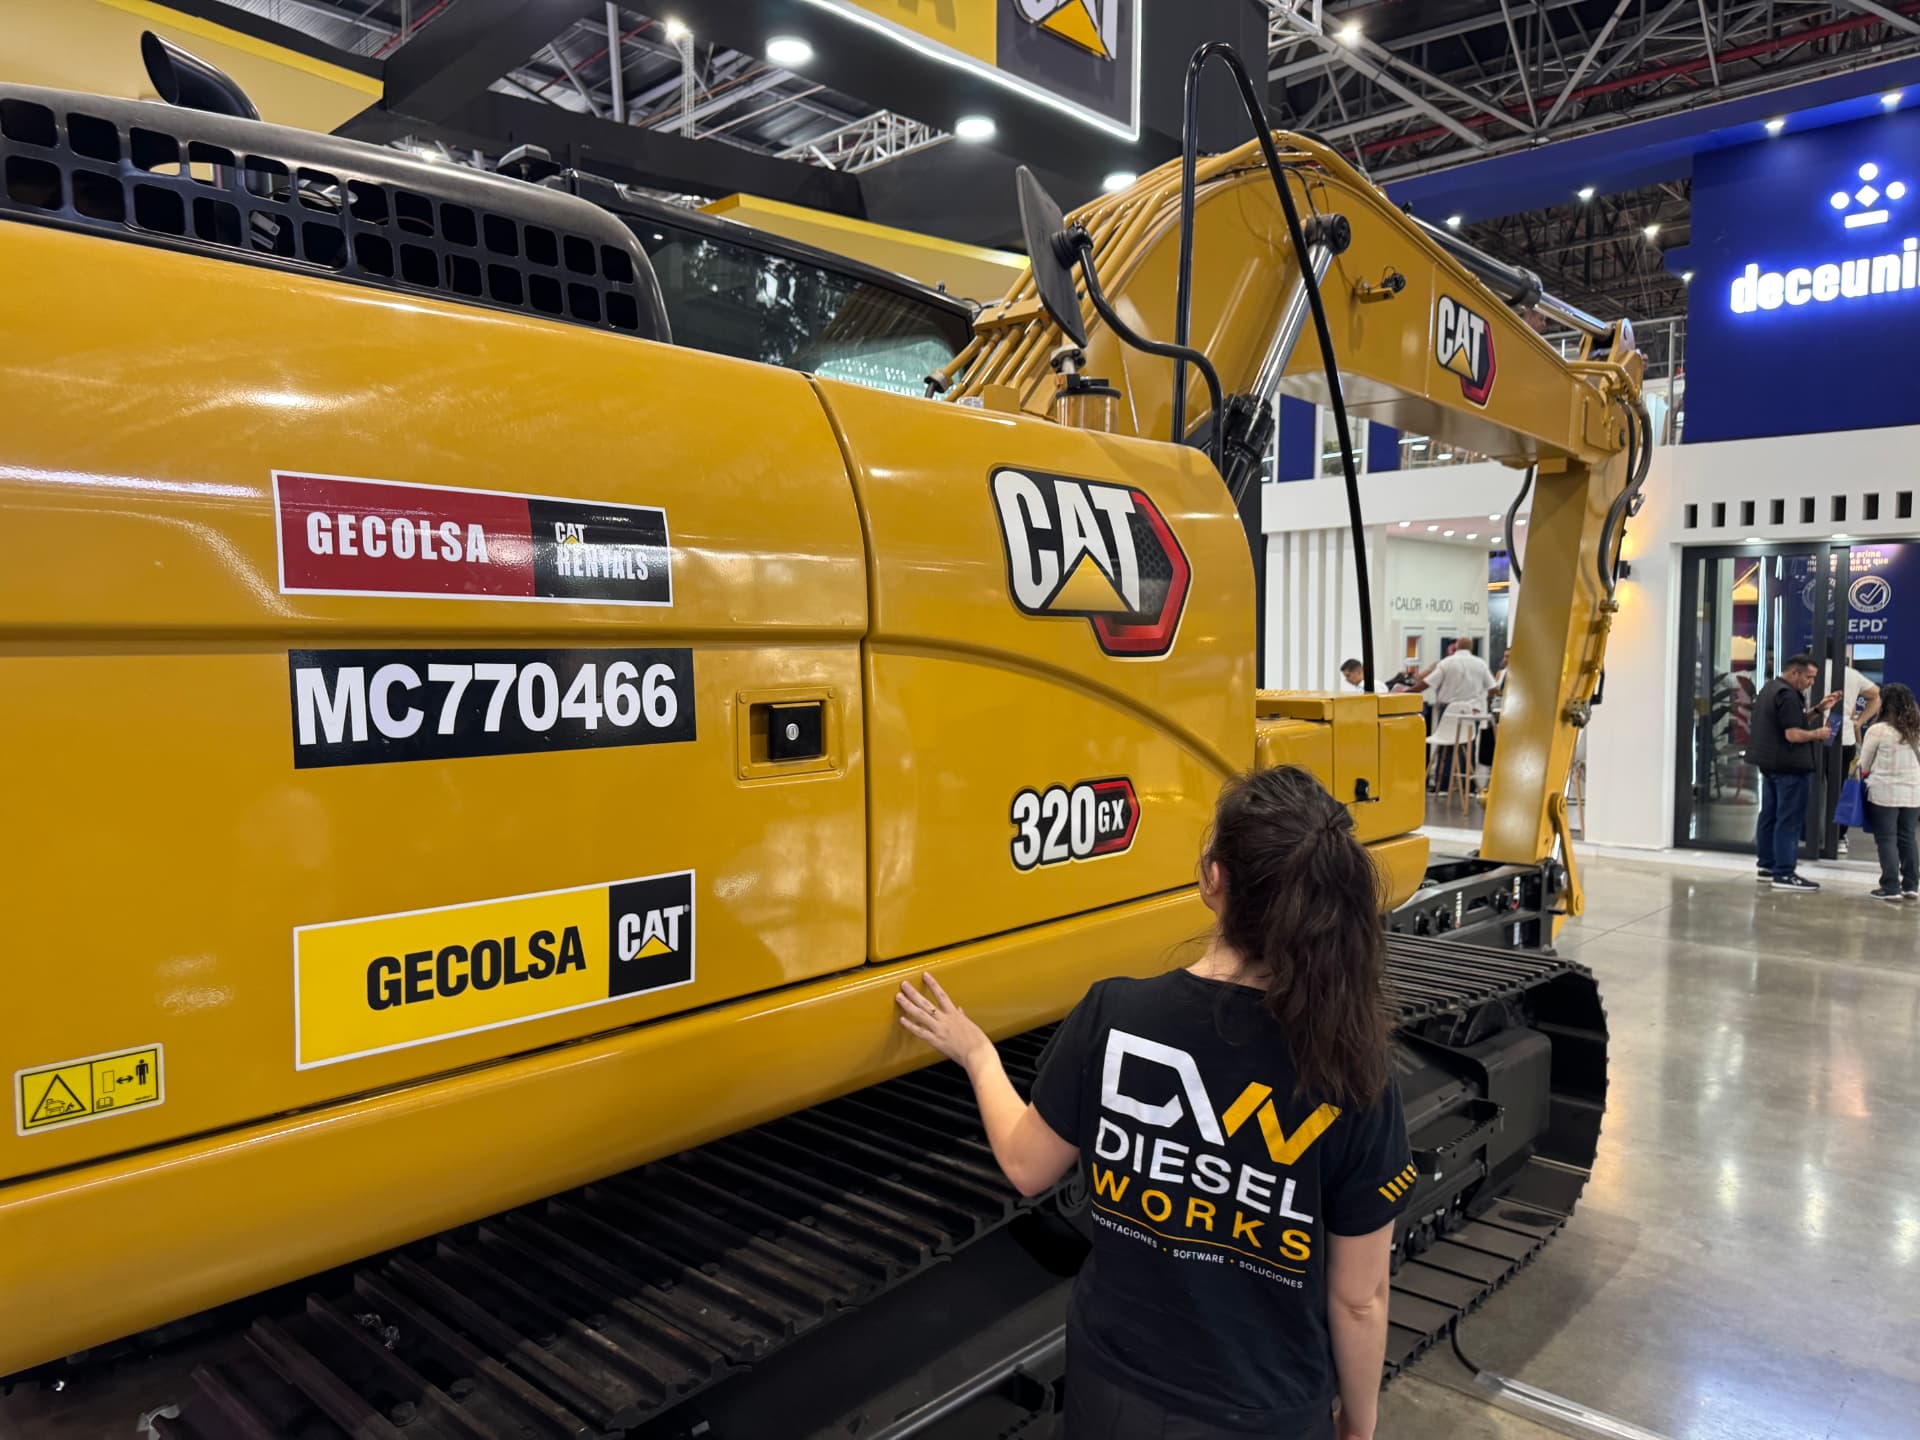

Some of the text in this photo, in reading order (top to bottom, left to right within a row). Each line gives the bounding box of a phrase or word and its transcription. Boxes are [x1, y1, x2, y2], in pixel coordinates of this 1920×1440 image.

[1730, 237, 1920, 313] deceuni
[1437, 297, 1485, 381] CAT
[306, 511, 489, 563] GECOLSA
[554, 521, 586, 545] CAT
[556, 543, 650, 581] RENTALS
[994, 470, 1141, 612] CAT
[1395, 596, 1421, 611] CALOR
[295, 662, 678, 746] MC770466
[366, 904, 685, 1011] GECOLSA CAT
[1095, 1116, 1314, 1224] DIESEL
[1092, 1162, 1312, 1261] WORKS
[1173, 1248, 1225, 1264] SOFTWARE
[1239, 1260, 1304, 1289] SOLUCIONES
